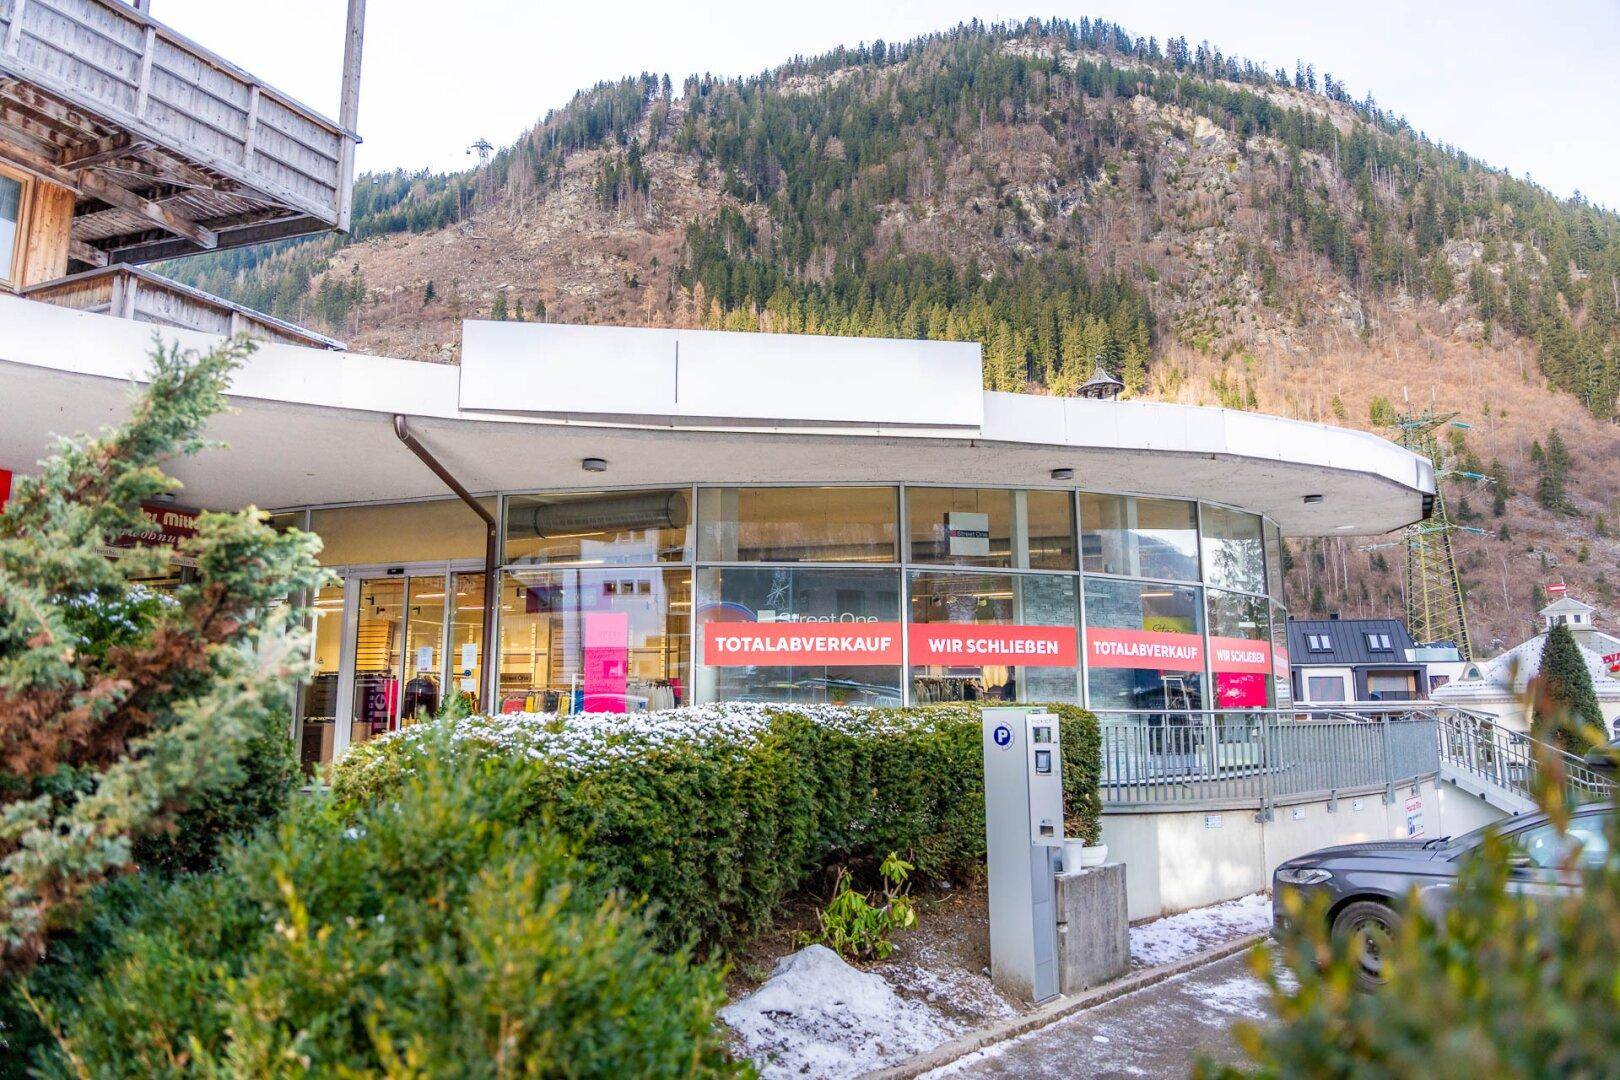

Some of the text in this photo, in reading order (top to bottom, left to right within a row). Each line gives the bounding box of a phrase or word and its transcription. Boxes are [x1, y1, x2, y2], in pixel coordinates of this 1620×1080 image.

[715, 637, 892, 652] TOTALABVERKAUF
[928, 638, 962, 653] WIR
[1094, 641, 1199, 660] TOTALABVERKAUF
[1216, 649, 1230, 661] WIR
